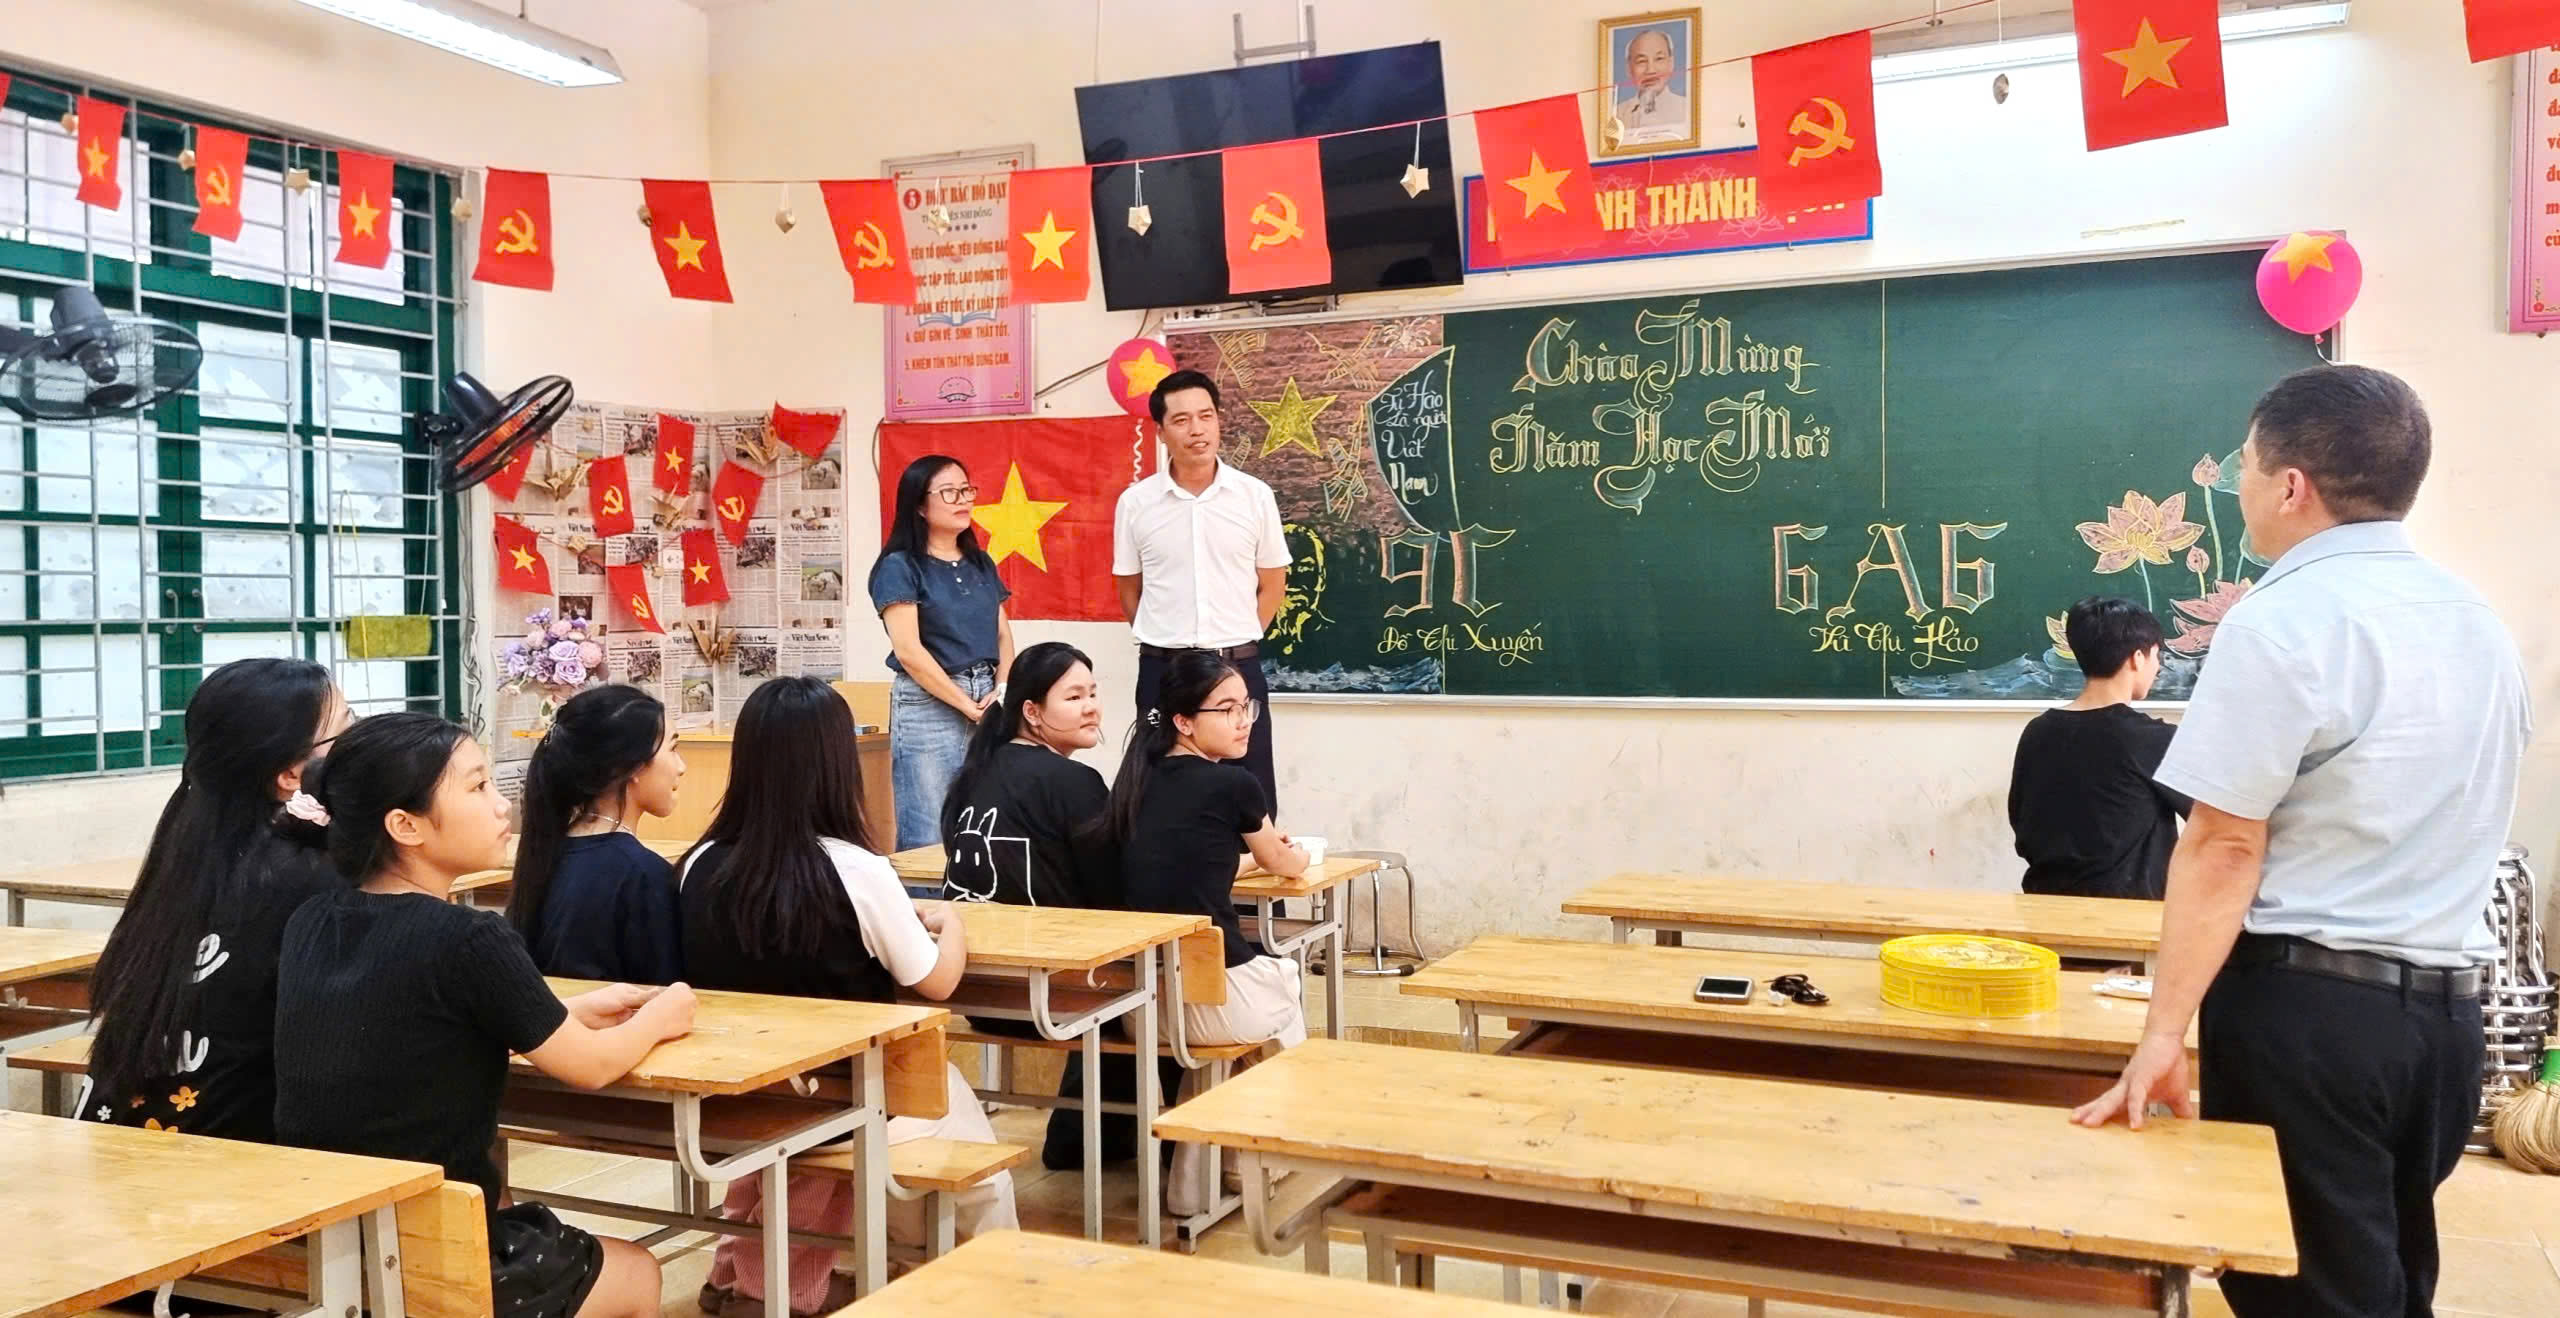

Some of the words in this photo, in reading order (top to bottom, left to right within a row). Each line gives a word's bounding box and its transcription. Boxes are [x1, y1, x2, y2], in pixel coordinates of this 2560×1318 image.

[1646, 177, 1757, 227] THANH
[1512, 317, 1640, 394] Chào
[1634, 298, 1820, 396] Mừng
[1403, 369, 1444, 417] Hào
[1490, 403, 1600, 474] Năm
[1592, 396, 1703, 516] Học
[1700, 389, 1832, 493] Mới
[1388, 461, 1439, 505] Nam
[1377, 626, 1412, 654] Đỗ
